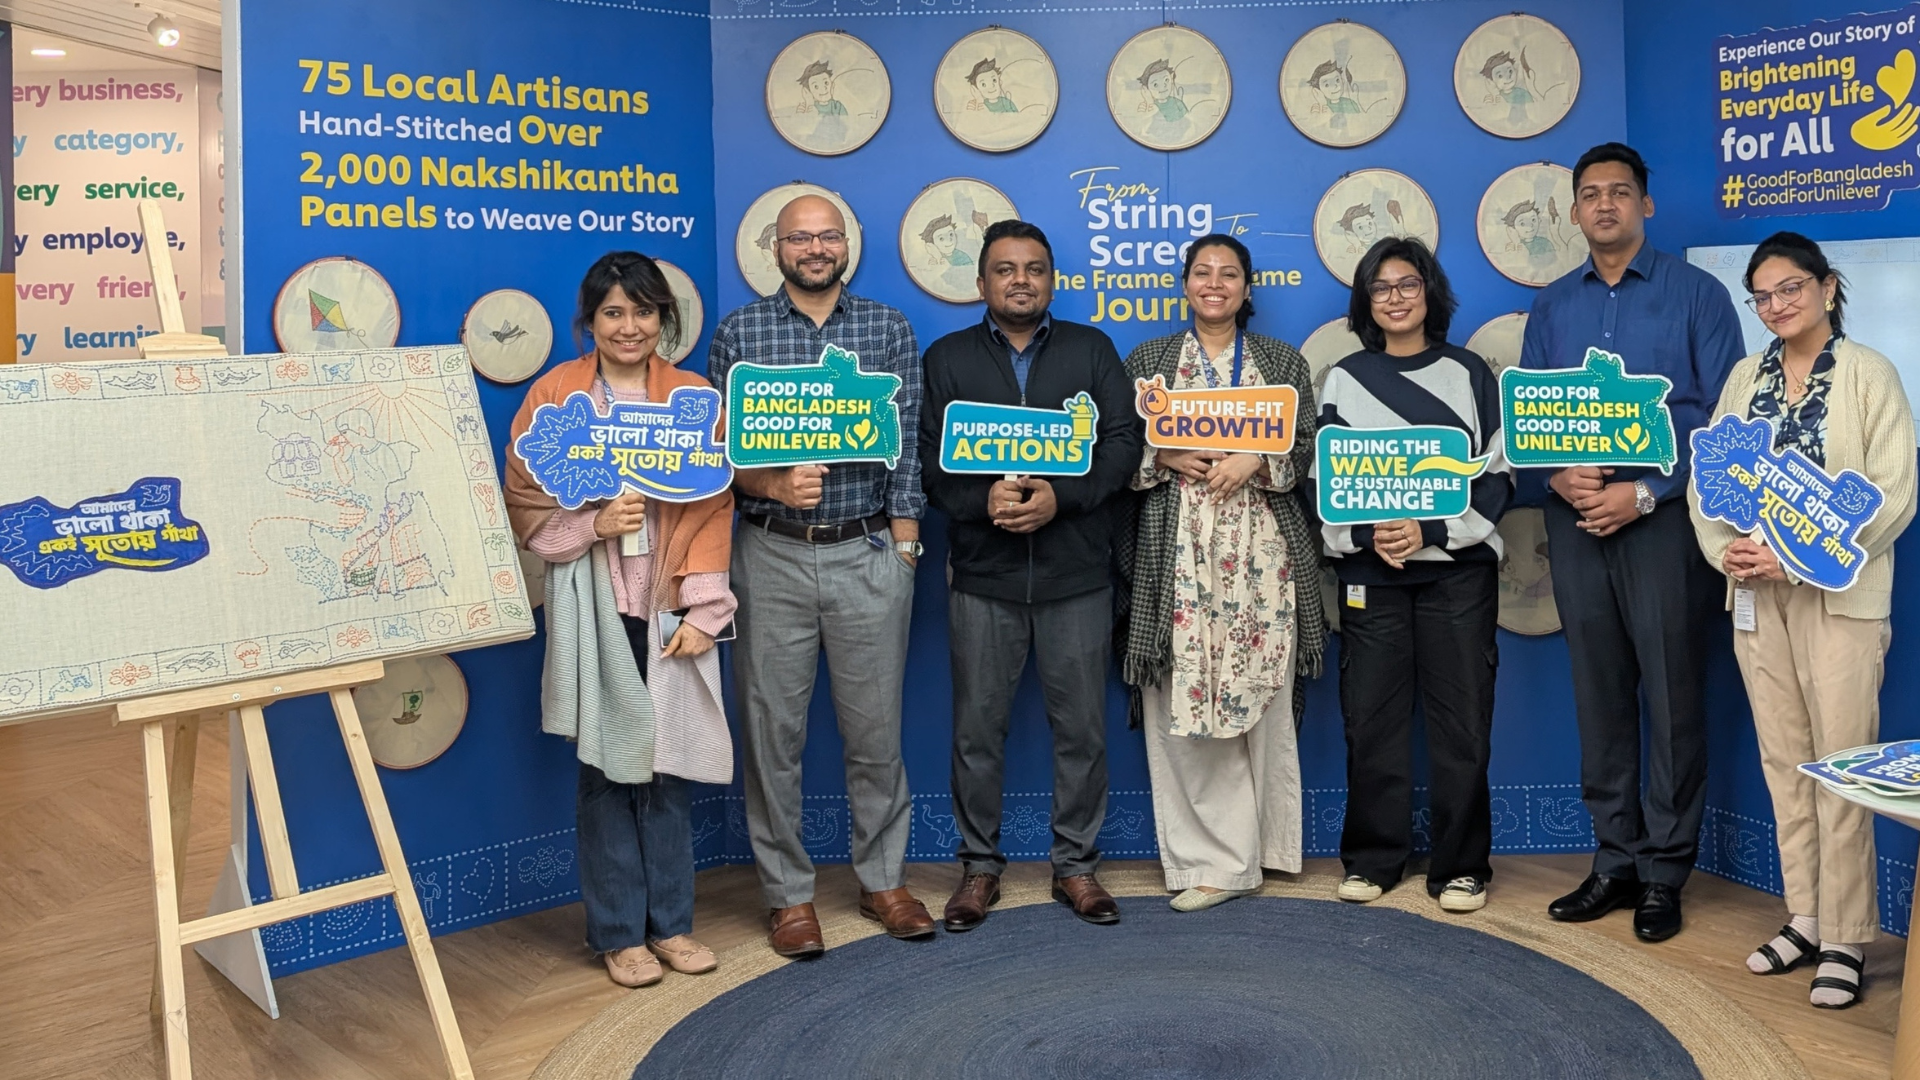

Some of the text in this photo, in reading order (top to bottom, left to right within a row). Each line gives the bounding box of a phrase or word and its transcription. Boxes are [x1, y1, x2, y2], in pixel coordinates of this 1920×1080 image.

[1719, 15, 1916, 64] Experience Our Story of
[1720, 54, 1855, 92] Brightening
[13, 78, 183, 107] ery business,
[299, 59, 649, 115] 75 Local Artisans
[1721, 80, 1875, 120] Everyday Life
[300, 110, 603, 147] Hand-Stitched Over
[1721, 116, 1834, 162] for All
[54, 130, 184, 155] category,
[300, 151, 680, 194] 2,000 Nakshikantha
[1747, 160, 1913, 188] GoodForBangladesh
[14, 176, 185, 207] ery service,
[1070, 166, 1160, 209] From
[1748, 184, 1881, 206] GoodForUnilever
[301, 195, 695, 239] Panels to Weave Our Story
[1088, 195, 1259, 237] String To
[43, 227, 185, 255] employe,
[1089, 235, 1193, 267] Scre
[1053, 269, 1087, 290] he
[1093, 270, 1175, 289] Frame
[1251, 270, 1302, 287] ame
[17, 283, 75, 305] very
[1090, 292, 1189, 323] Jour
[744, 382, 834, 397] GOOD FOR
[1514, 385, 1600, 400] GOOD FOR
[619, 411, 675, 427] আমাদের
[743, 398, 871, 415] BANGLADESH
[1171, 400, 1284, 417] FUTURE-FIT
[1514, 401, 1640, 418] BANGLADESH
[742, 416, 832, 431] GOOD FOR
[952, 422, 1073, 438] PURPOSE-LED
[1155, 415, 1284, 439] GROWTH
[1515, 418, 1601, 434] GOOD FOR
[590, 424, 704, 449] ভালো থাকা
[741, 433, 841, 450] UNILEVER
[1330, 439, 1441, 455] RIDING THE
[1515, 434, 1613, 453] UNILEVER
[566, 443, 606, 462] একই
[688, 445, 724, 468] গাঁথা
[952, 438, 1083, 462] ACTIONS
[1330, 456, 1408, 476] WAVE
[1727, 463, 1762, 492] একই
[1330, 477, 1461, 491] OF SUSTAINABLE
[1786, 459, 1833, 500] আমাদের
[79, 499, 136, 515] আমাদের
[1330, 490, 1434, 510] CHANGE
[1753, 455, 1849, 538] ভালো থাকা
[53, 508, 171, 536] ভালো থাকা
[38, 534, 78, 555] একই
